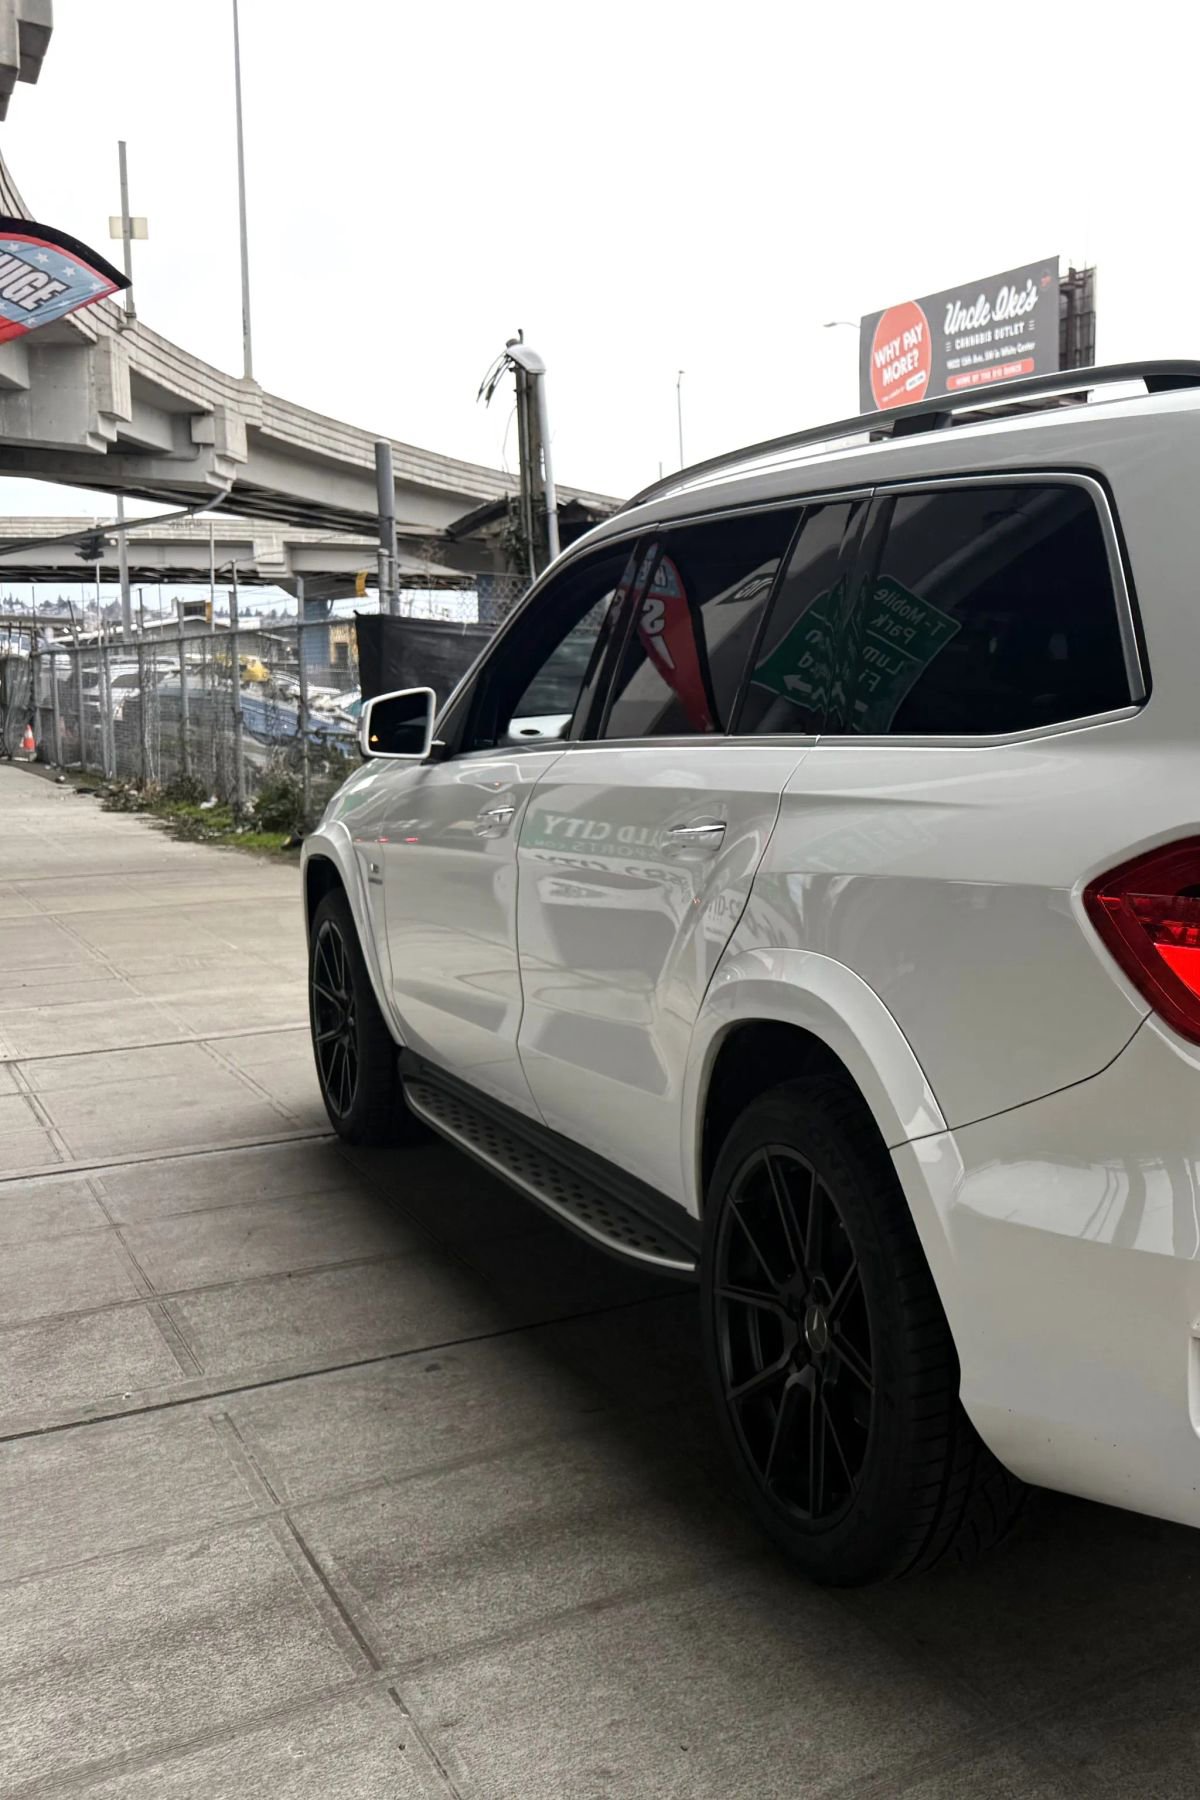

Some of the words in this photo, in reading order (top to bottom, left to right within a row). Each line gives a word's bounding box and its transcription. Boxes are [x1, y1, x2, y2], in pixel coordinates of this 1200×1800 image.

[944, 293, 991, 335] Uncle
[992, 278, 1039, 321] Ike's
[874, 336, 902, 370] WHY
[902, 321, 924, 352] PAY
[994, 321, 1026, 341] OUTLET
[882, 348, 920, 387] MORE?
